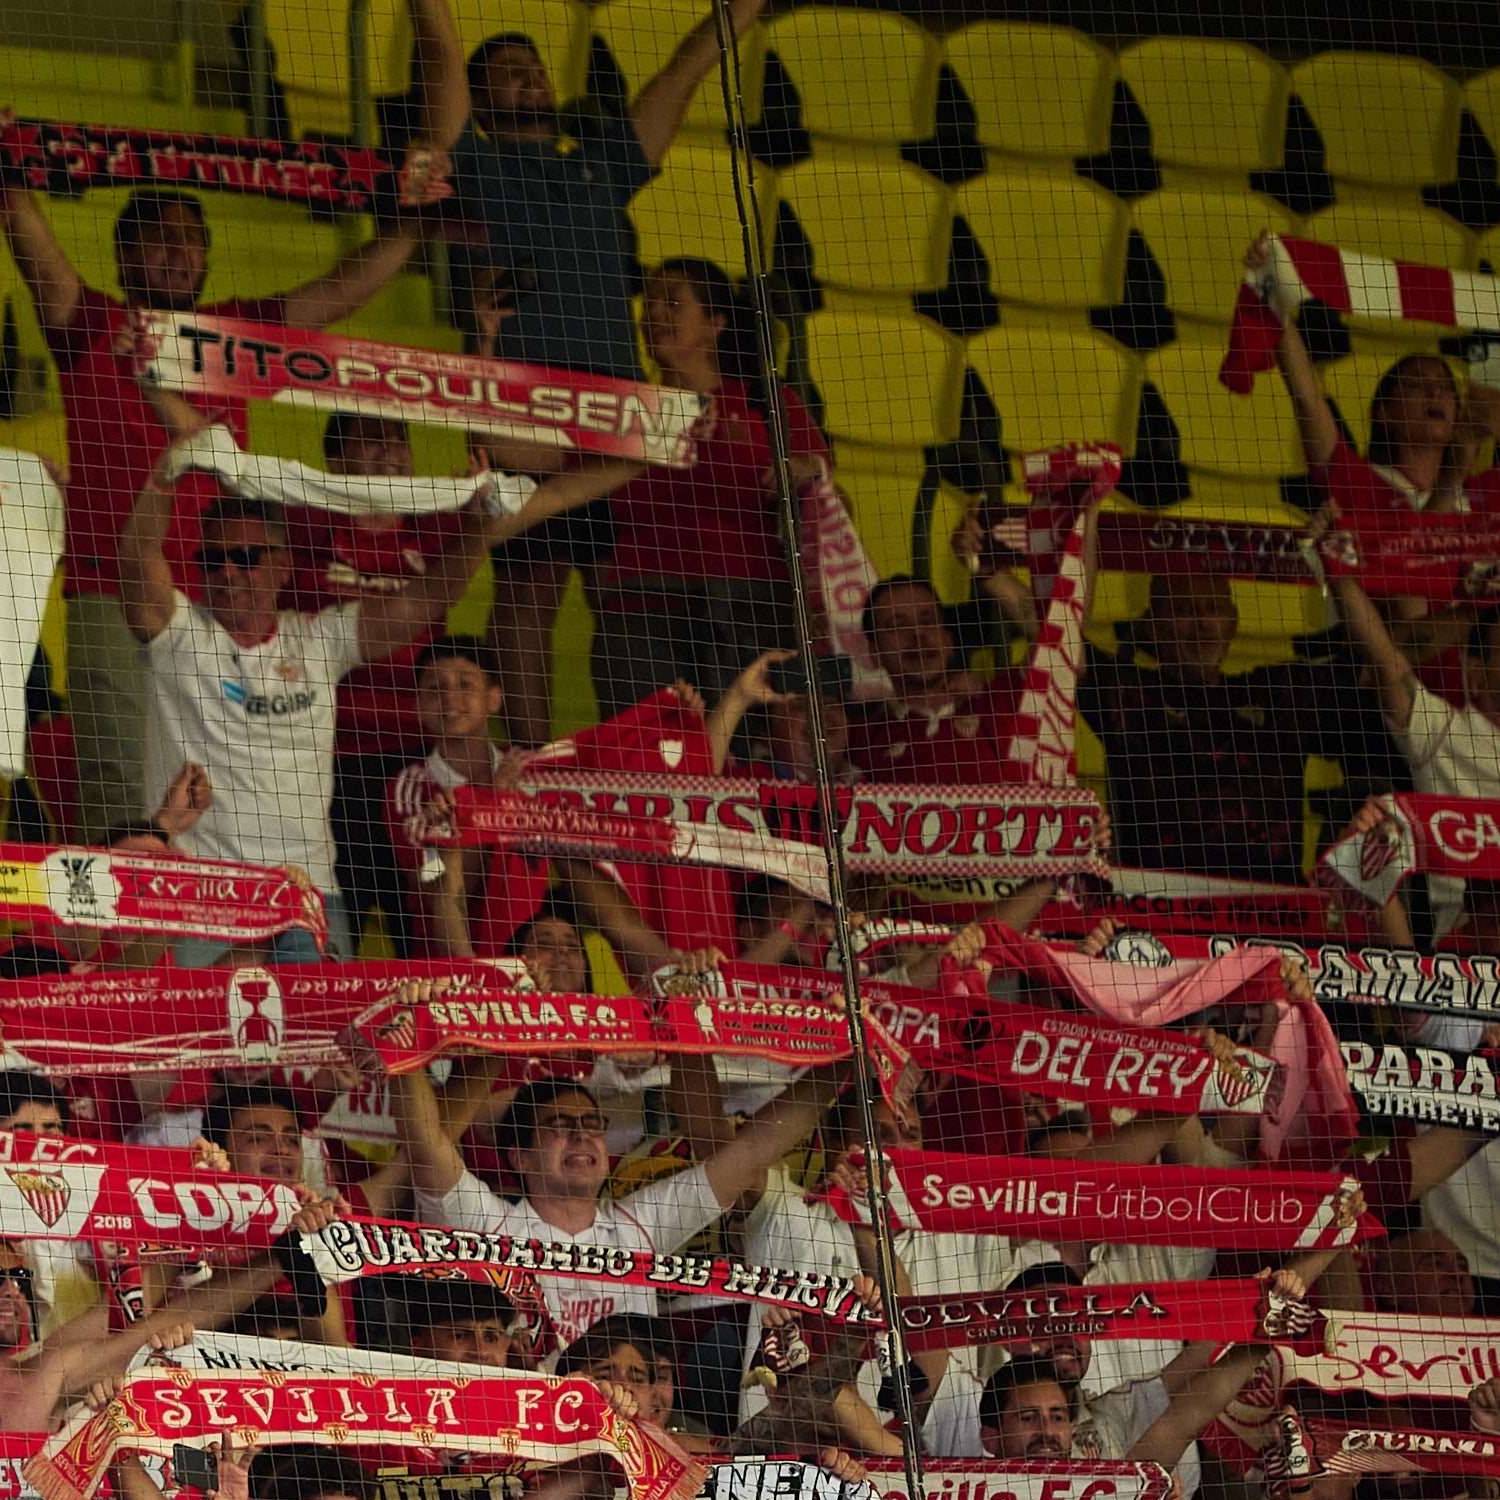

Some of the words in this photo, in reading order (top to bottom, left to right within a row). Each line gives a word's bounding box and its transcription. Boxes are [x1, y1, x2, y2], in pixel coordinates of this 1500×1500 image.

[847, 800, 1100, 859] NORTE
[428, 1001, 565, 1028] SEVILLA
[1012, 1031, 1091, 1088] DEL
[1106, 1048, 1208, 1098] REY
[1341, 1042, 1500, 1098] PARA
[94, 1214, 132, 1229] 2018
[127, 1176, 301, 1233] COPA
[967, 1322, 1018, 1338] casta
[155, 1386, 458, 1428] SEVILLA
